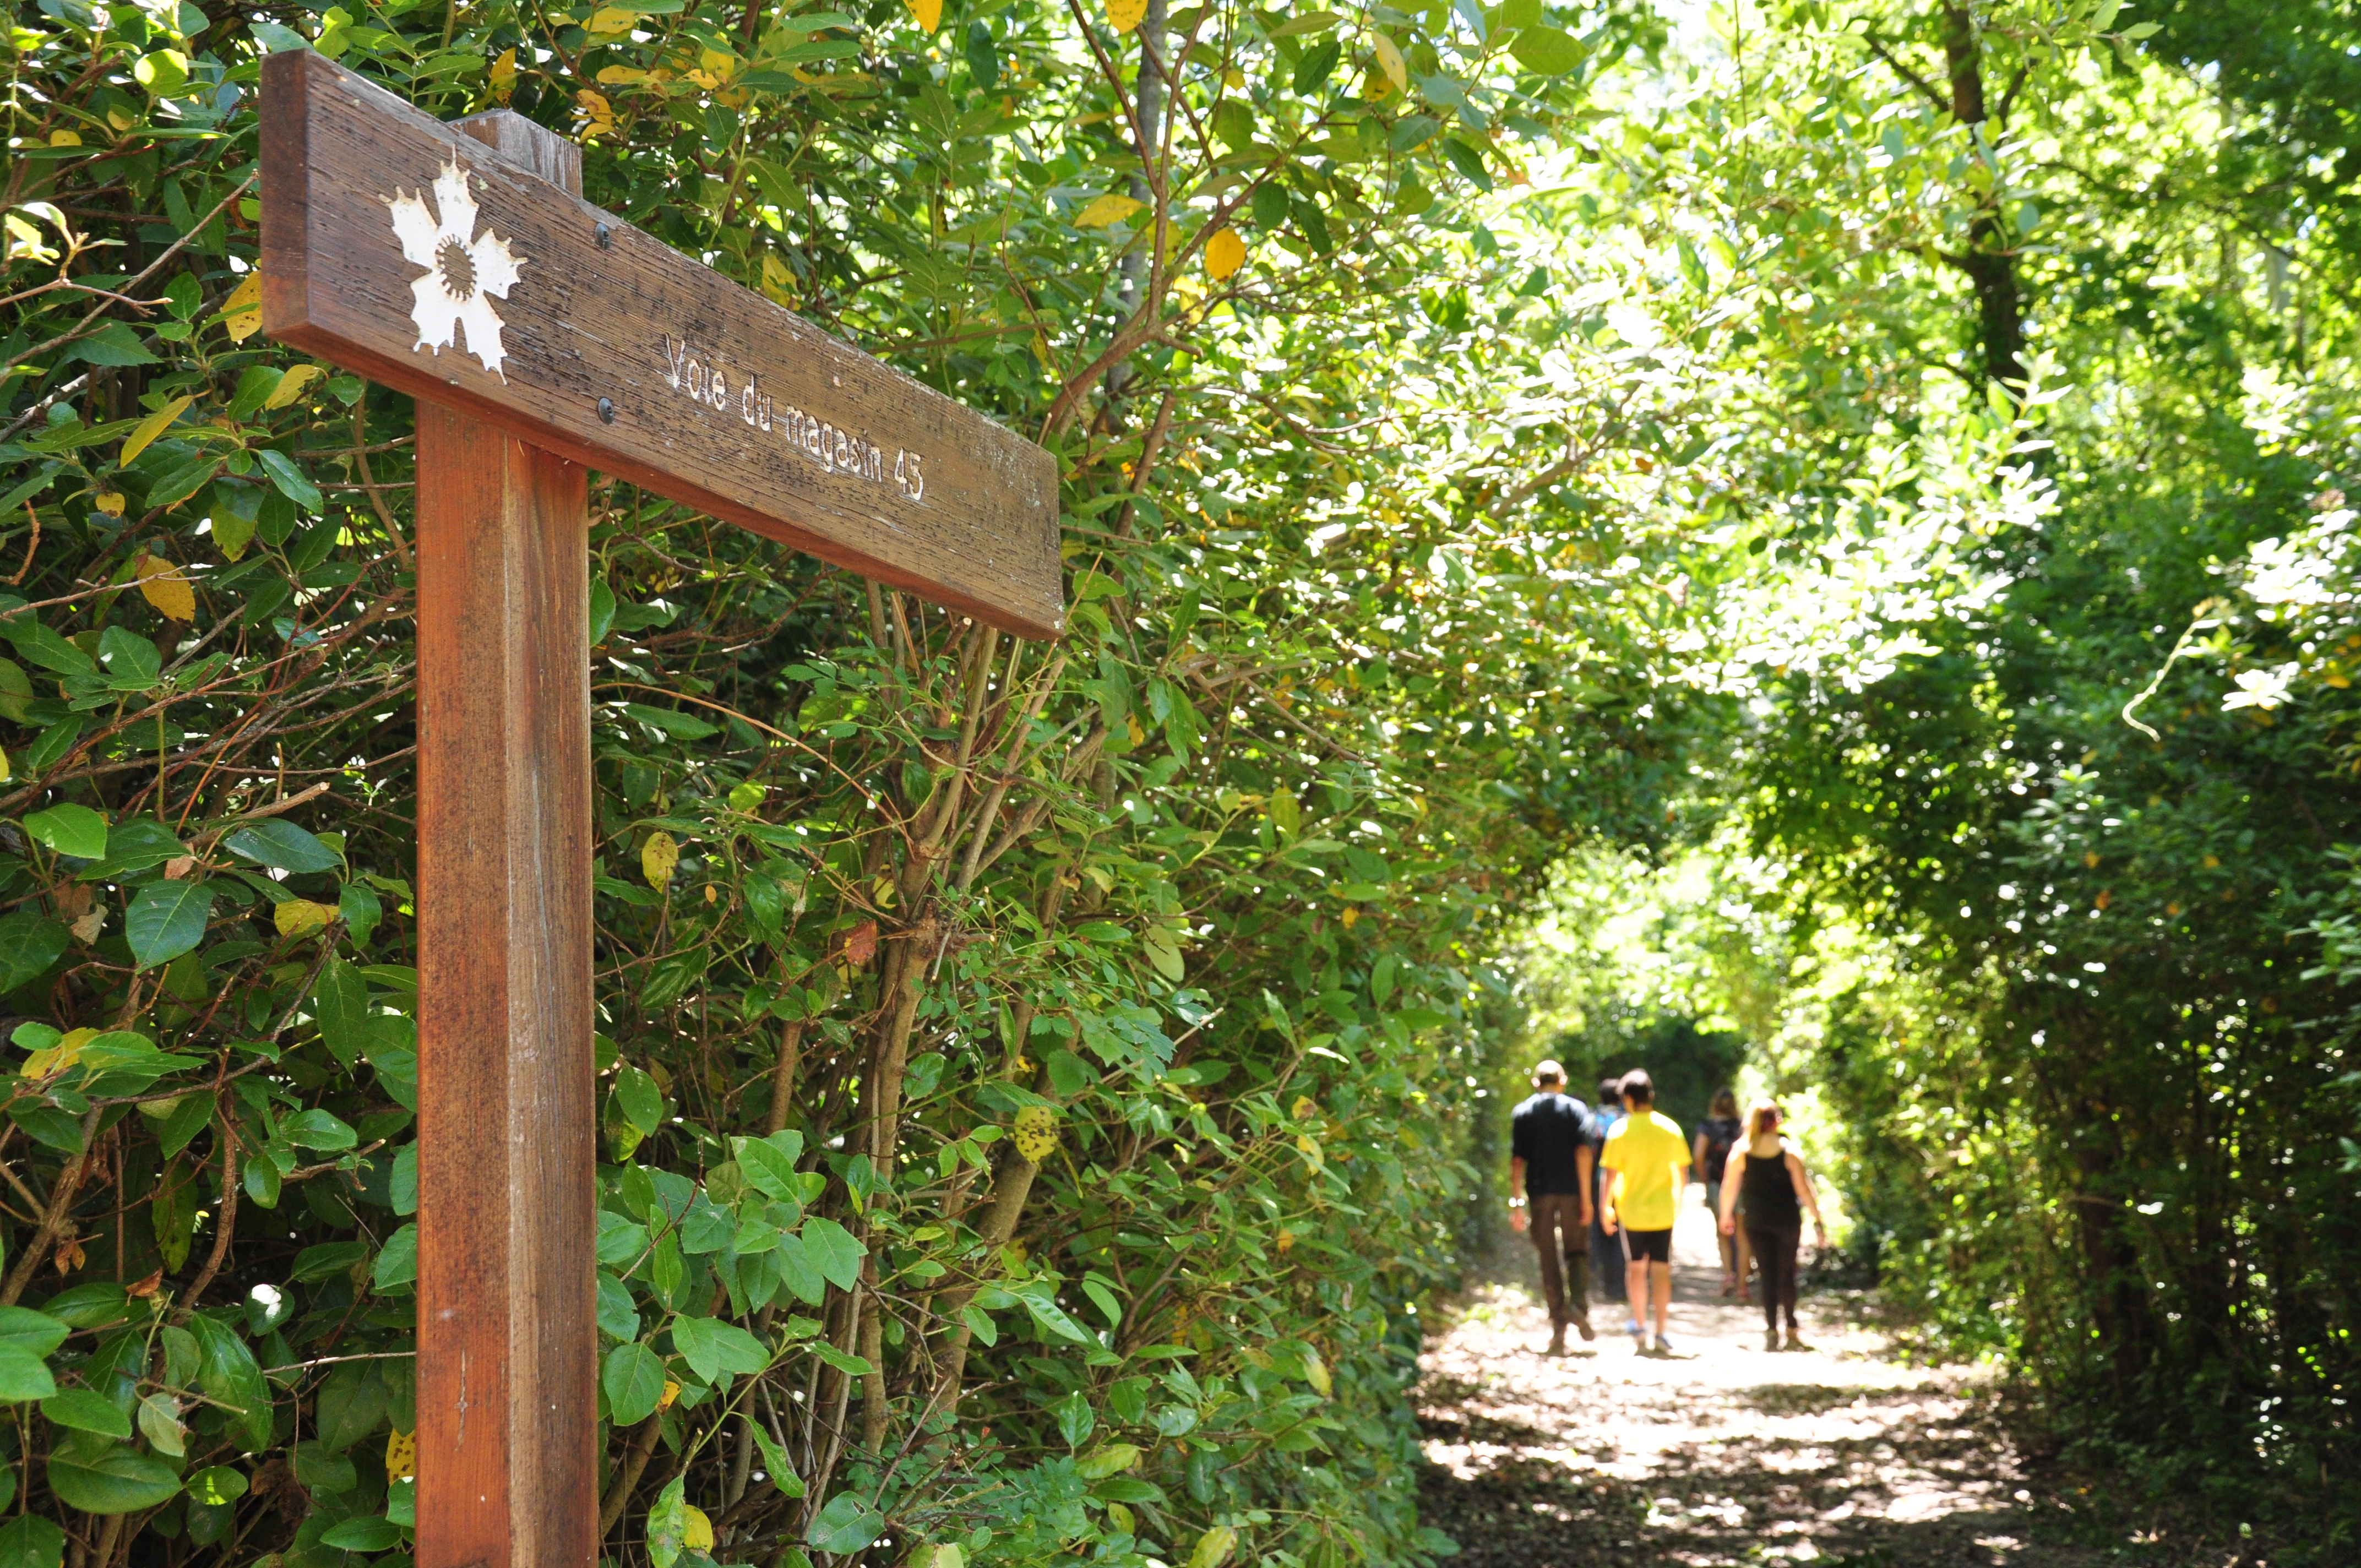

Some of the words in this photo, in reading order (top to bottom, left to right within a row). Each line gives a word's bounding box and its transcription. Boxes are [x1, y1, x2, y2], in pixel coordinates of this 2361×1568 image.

[664, 331, 726, 411] Voie
[741, 374, 772, 432] du
[786, 405, 882, 482] magasin
[894, 447, 924, 502] 45
